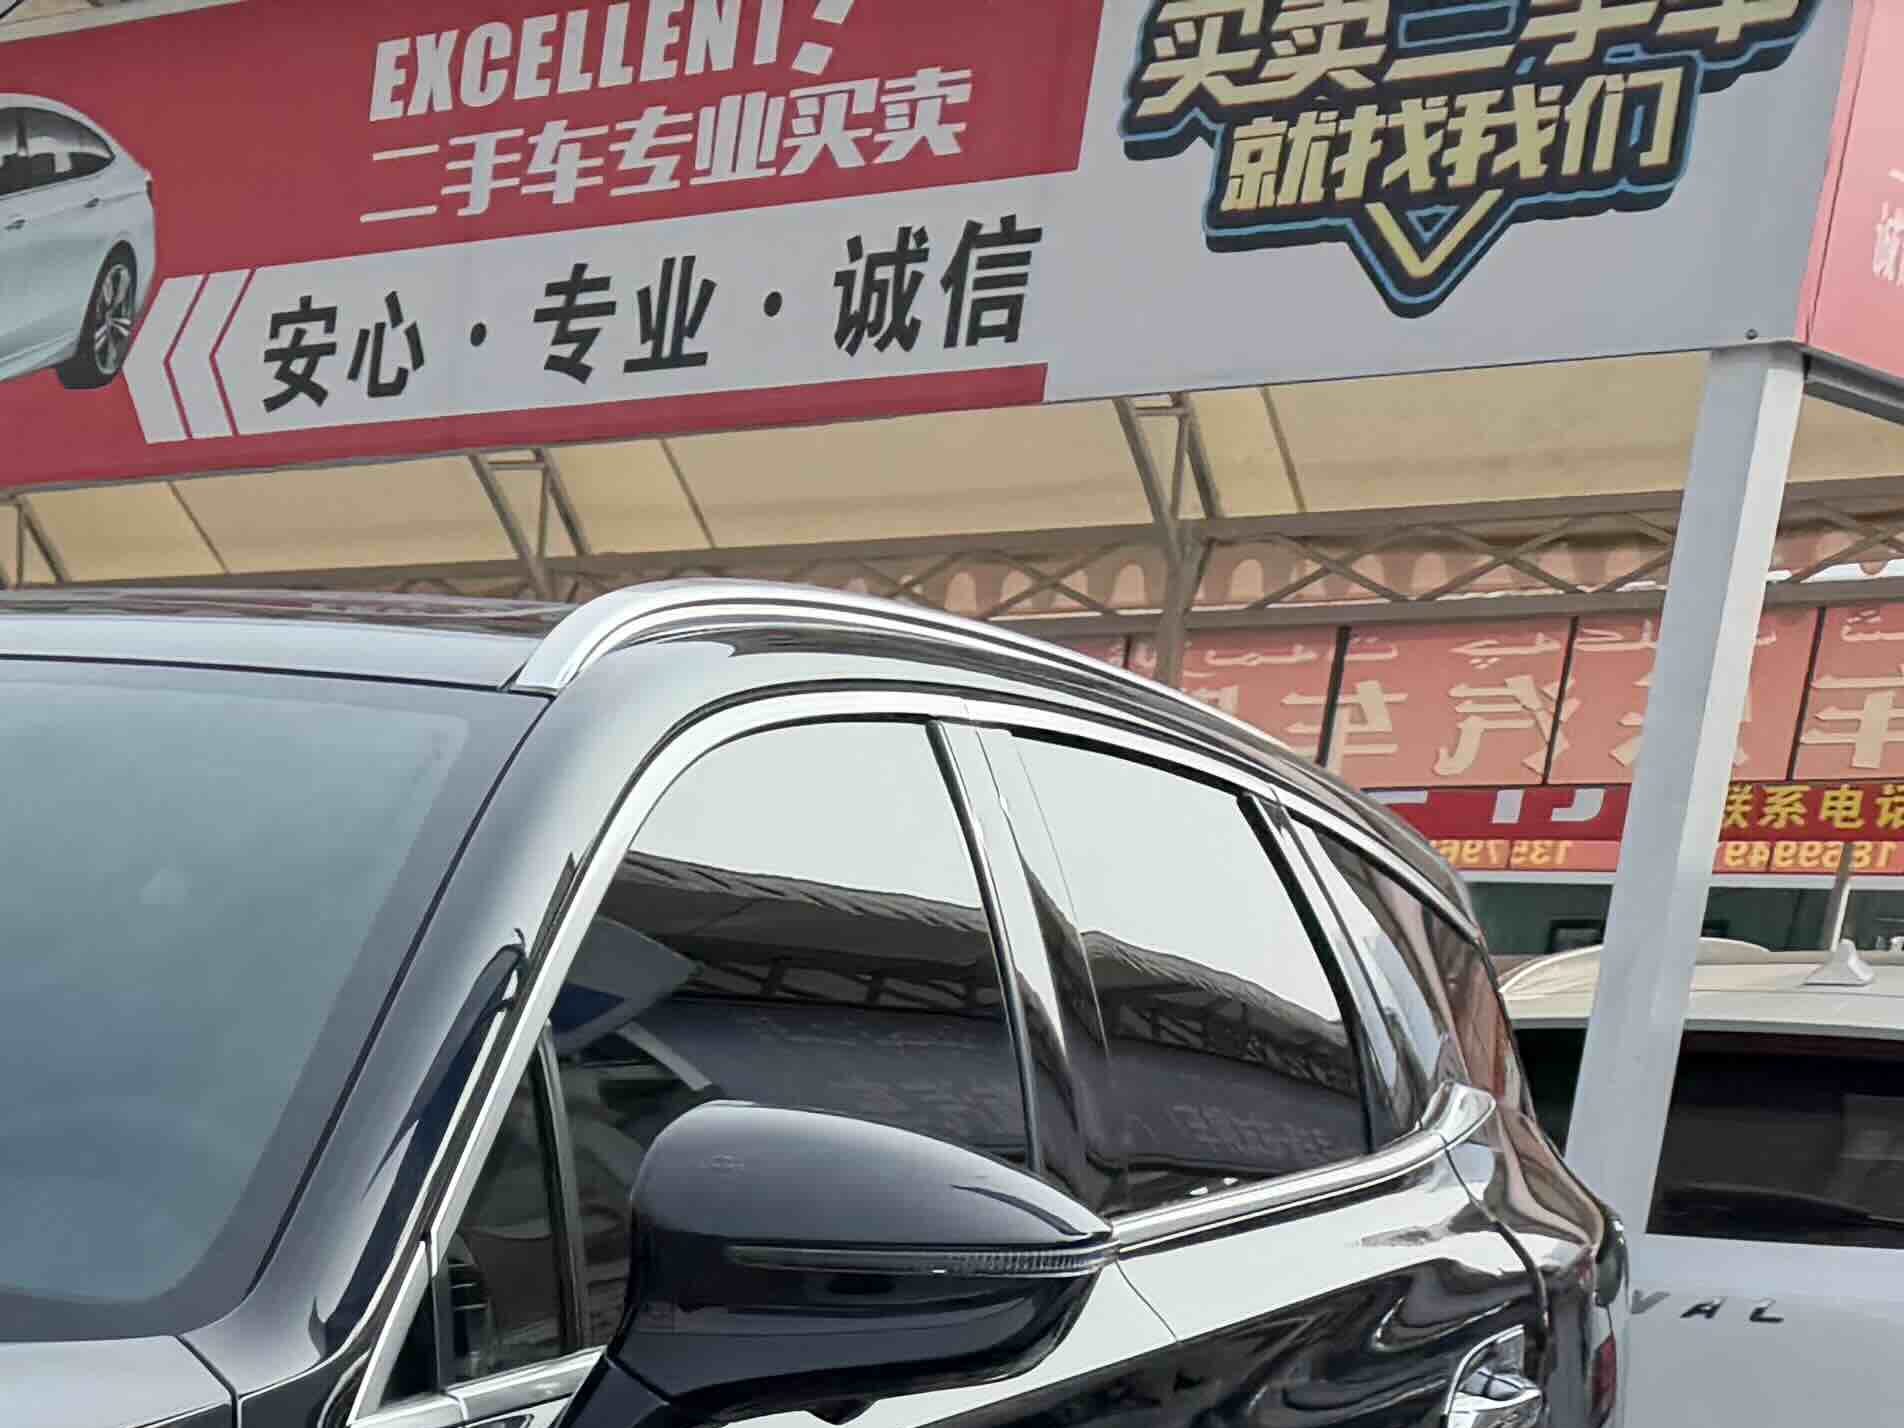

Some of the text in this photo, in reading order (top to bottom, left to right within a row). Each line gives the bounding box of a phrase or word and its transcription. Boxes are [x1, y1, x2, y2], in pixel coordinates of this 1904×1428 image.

[359, 66, 972, 225] 二手车专业买卖
[1220, 66, 1685, 211] 就找我们
